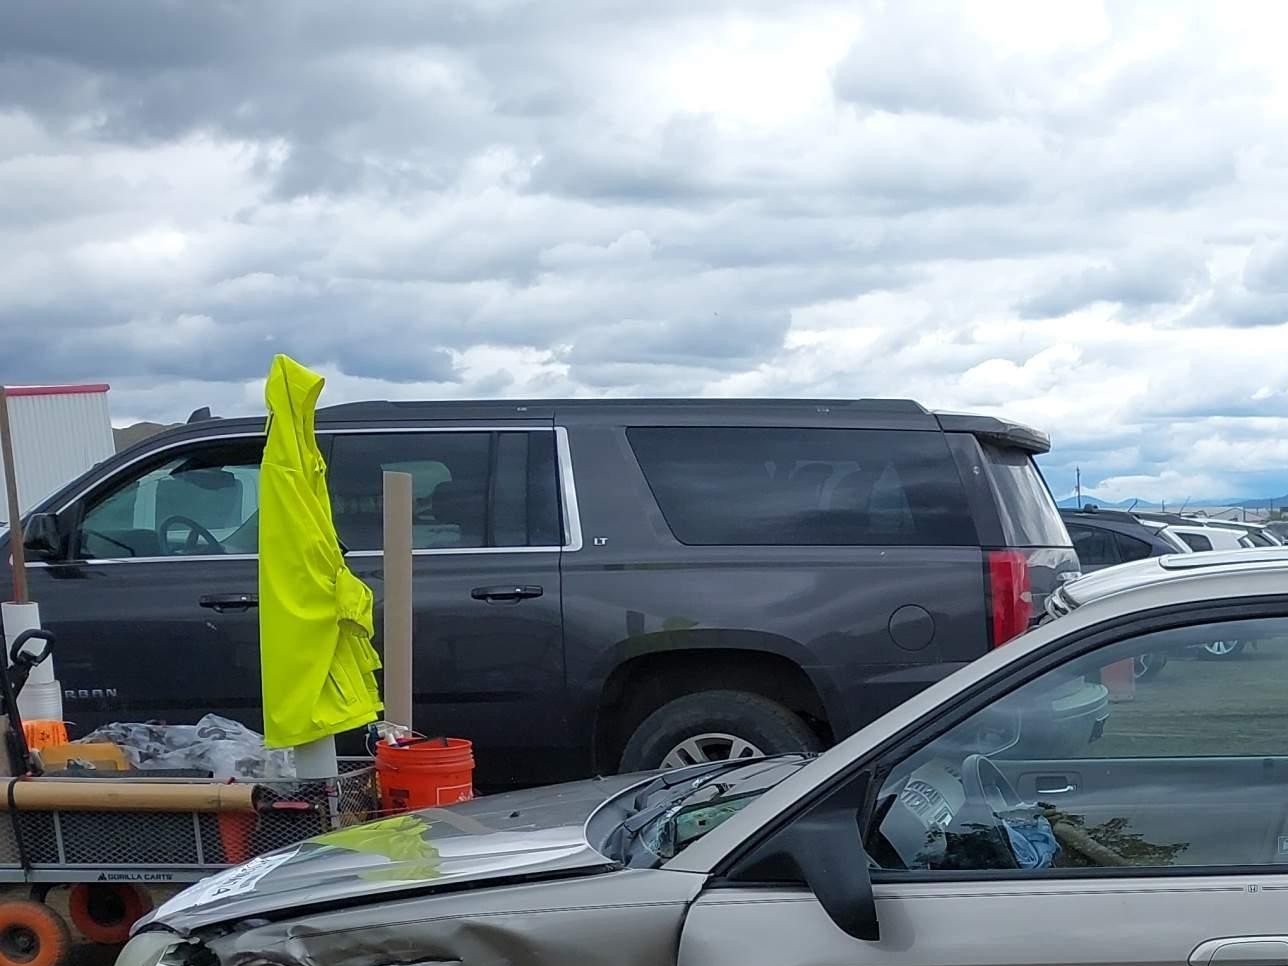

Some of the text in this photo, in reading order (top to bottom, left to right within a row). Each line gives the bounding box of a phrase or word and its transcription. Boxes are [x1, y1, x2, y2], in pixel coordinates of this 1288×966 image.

[594, 537, 609, 546] LT
[64, 688, 117, 699] RBAN
[107, 872, 143, 881] GORILLA
